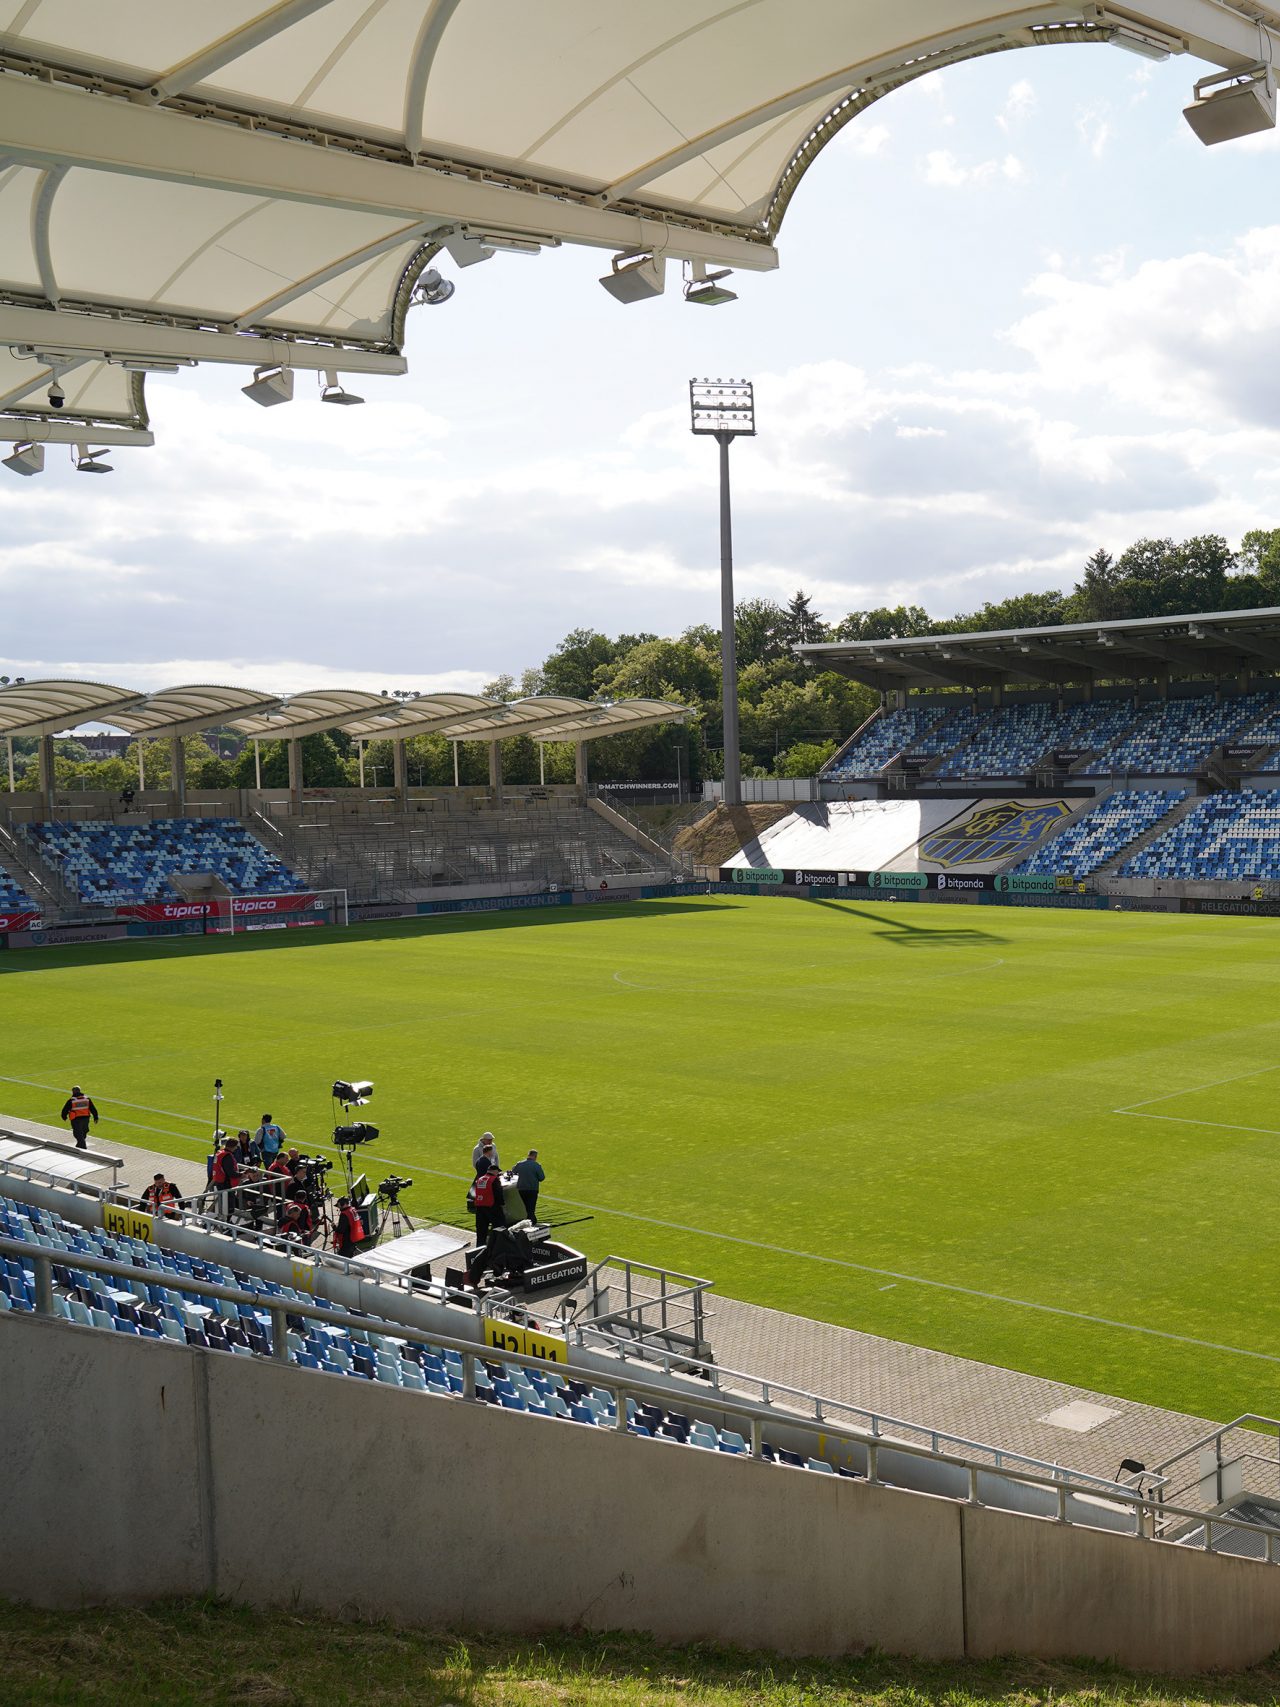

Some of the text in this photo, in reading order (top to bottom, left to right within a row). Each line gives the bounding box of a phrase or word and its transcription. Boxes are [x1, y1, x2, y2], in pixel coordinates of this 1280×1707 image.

[746, 871, 777, 882] bitpanda
[804, 873, 836, 885] bitpanda
[884, 874, 921, 887] bitpanda
[948, 878, 984, 890] bitpanda
[1012, 878, 1054, 891] bitpanda
[233, 900, 277, 912] tipico
[461, 895, 560, 911] SAARBRUECKEN.DE
[1201, 902, 1280, 914] RELEGATION 2025
[164, 904, 210, 918] tipico
[108, 1213, 149, 1242] H3 H2
[531, 1266, 583, 1285] RELEGATION
